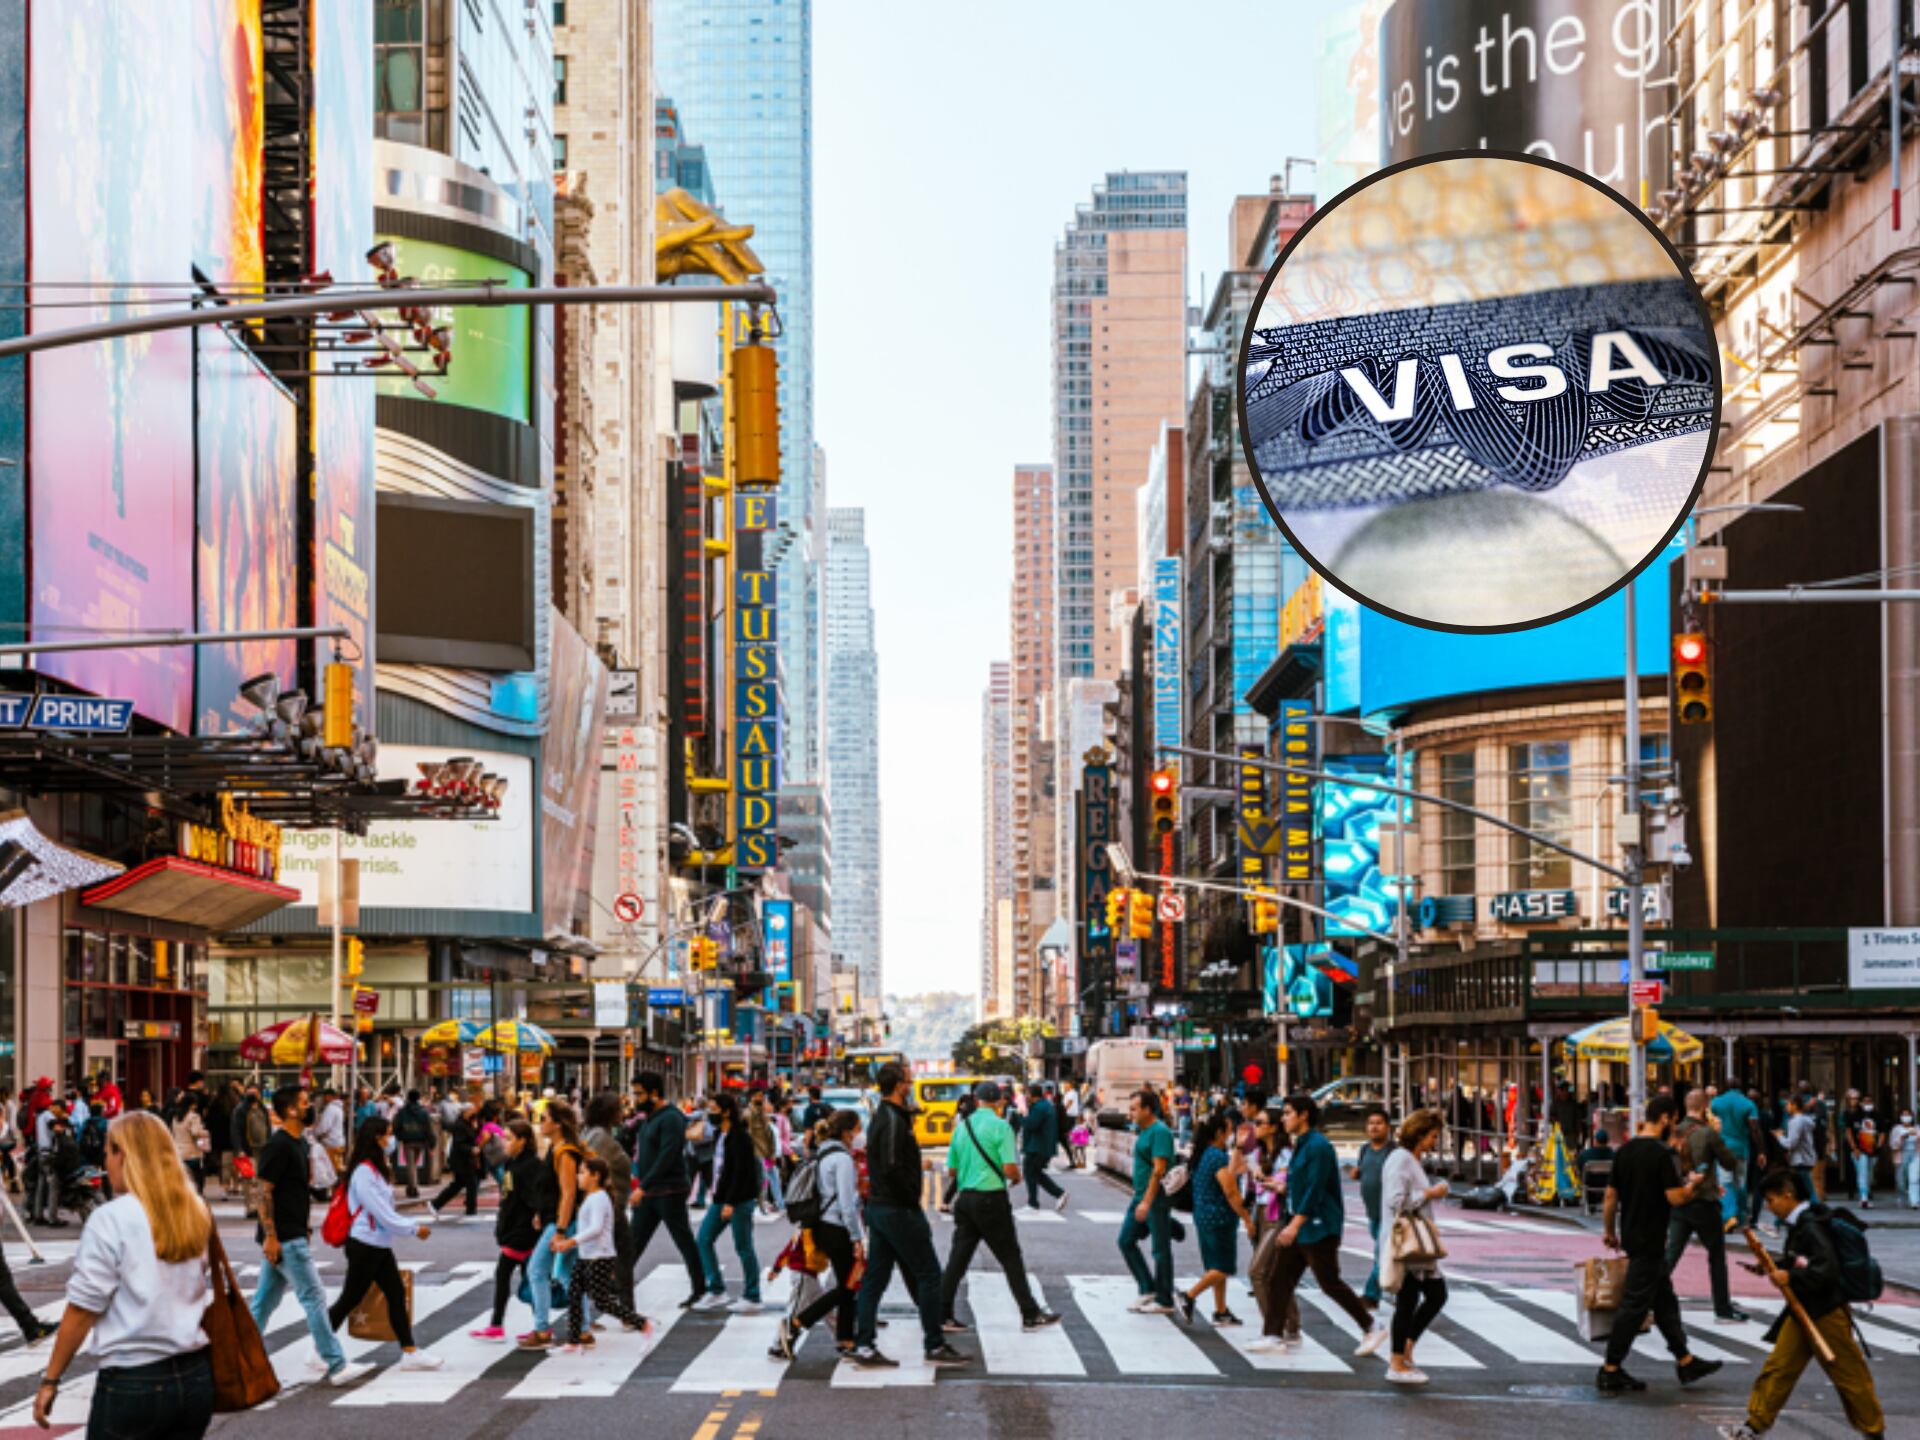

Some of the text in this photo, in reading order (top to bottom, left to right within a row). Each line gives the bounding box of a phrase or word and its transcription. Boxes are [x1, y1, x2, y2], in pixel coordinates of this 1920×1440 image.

[1425, 46, 1460, 120] is
[1474, 13, 1586, 96] the
[1270, 324, 1318, 337] AMERICA
[1318, 321, 1337, 330] THE
[1340, 315, 1378, 326] UNITED
[1284, 338, 1309, 349] RICA
[1309, 336, 1329, 345] THE
[1330, 331, 1369, 344] UNITED
[1370, 325, 1408, 336] STATES
[1316, 328, 1336, 336] THE
[1338, 323, 1376, 334] UNITED
[1376, 318, 1415, 330] STATES
[1284, 354, 1304, 363] THE
[1306, 348, 1344, 360] UNITED
[1345, 341, 1384, 355] STATES
[1384, 340, 1398, 348] OF
[1399, 333, 1447, 347] AMERICA
[1298, 345, 1318, 355] THE
[1320, 339, 1358, 351] UNITED
[1360, 333, 1398, 345] STATES
[1398, 331, 1411, 339] OF
[1273, 364, 1286, 373] HE
[1287, 356, 1326, 370] UNITED
[1382, 342, 1429, 356] AMERICA
[1266, 369, 1306, 381] UNITED
[1339, 329, 1667, 423] VISA
[1652, 399, 1704, 414] ERICA THE
[1683, 391, 1704, 403] THE
[1624, 433, 1660, 448] AMERICA
[1660, 430, 1678, 440] THE
[1679, 422, 1712, 436] UNITED
[1154, 558, 1179, 601] NEW
[43, 701, 124, 727] PRIME
[1285, 706, 1310, 879] NEW VICTORY
[364, 831, 417, 848] tackle
[1085, 773, 1110, 938] REGAL
[1493, 893, 1567, 917] HASE
[1873, 931, 1909, 945] Times
